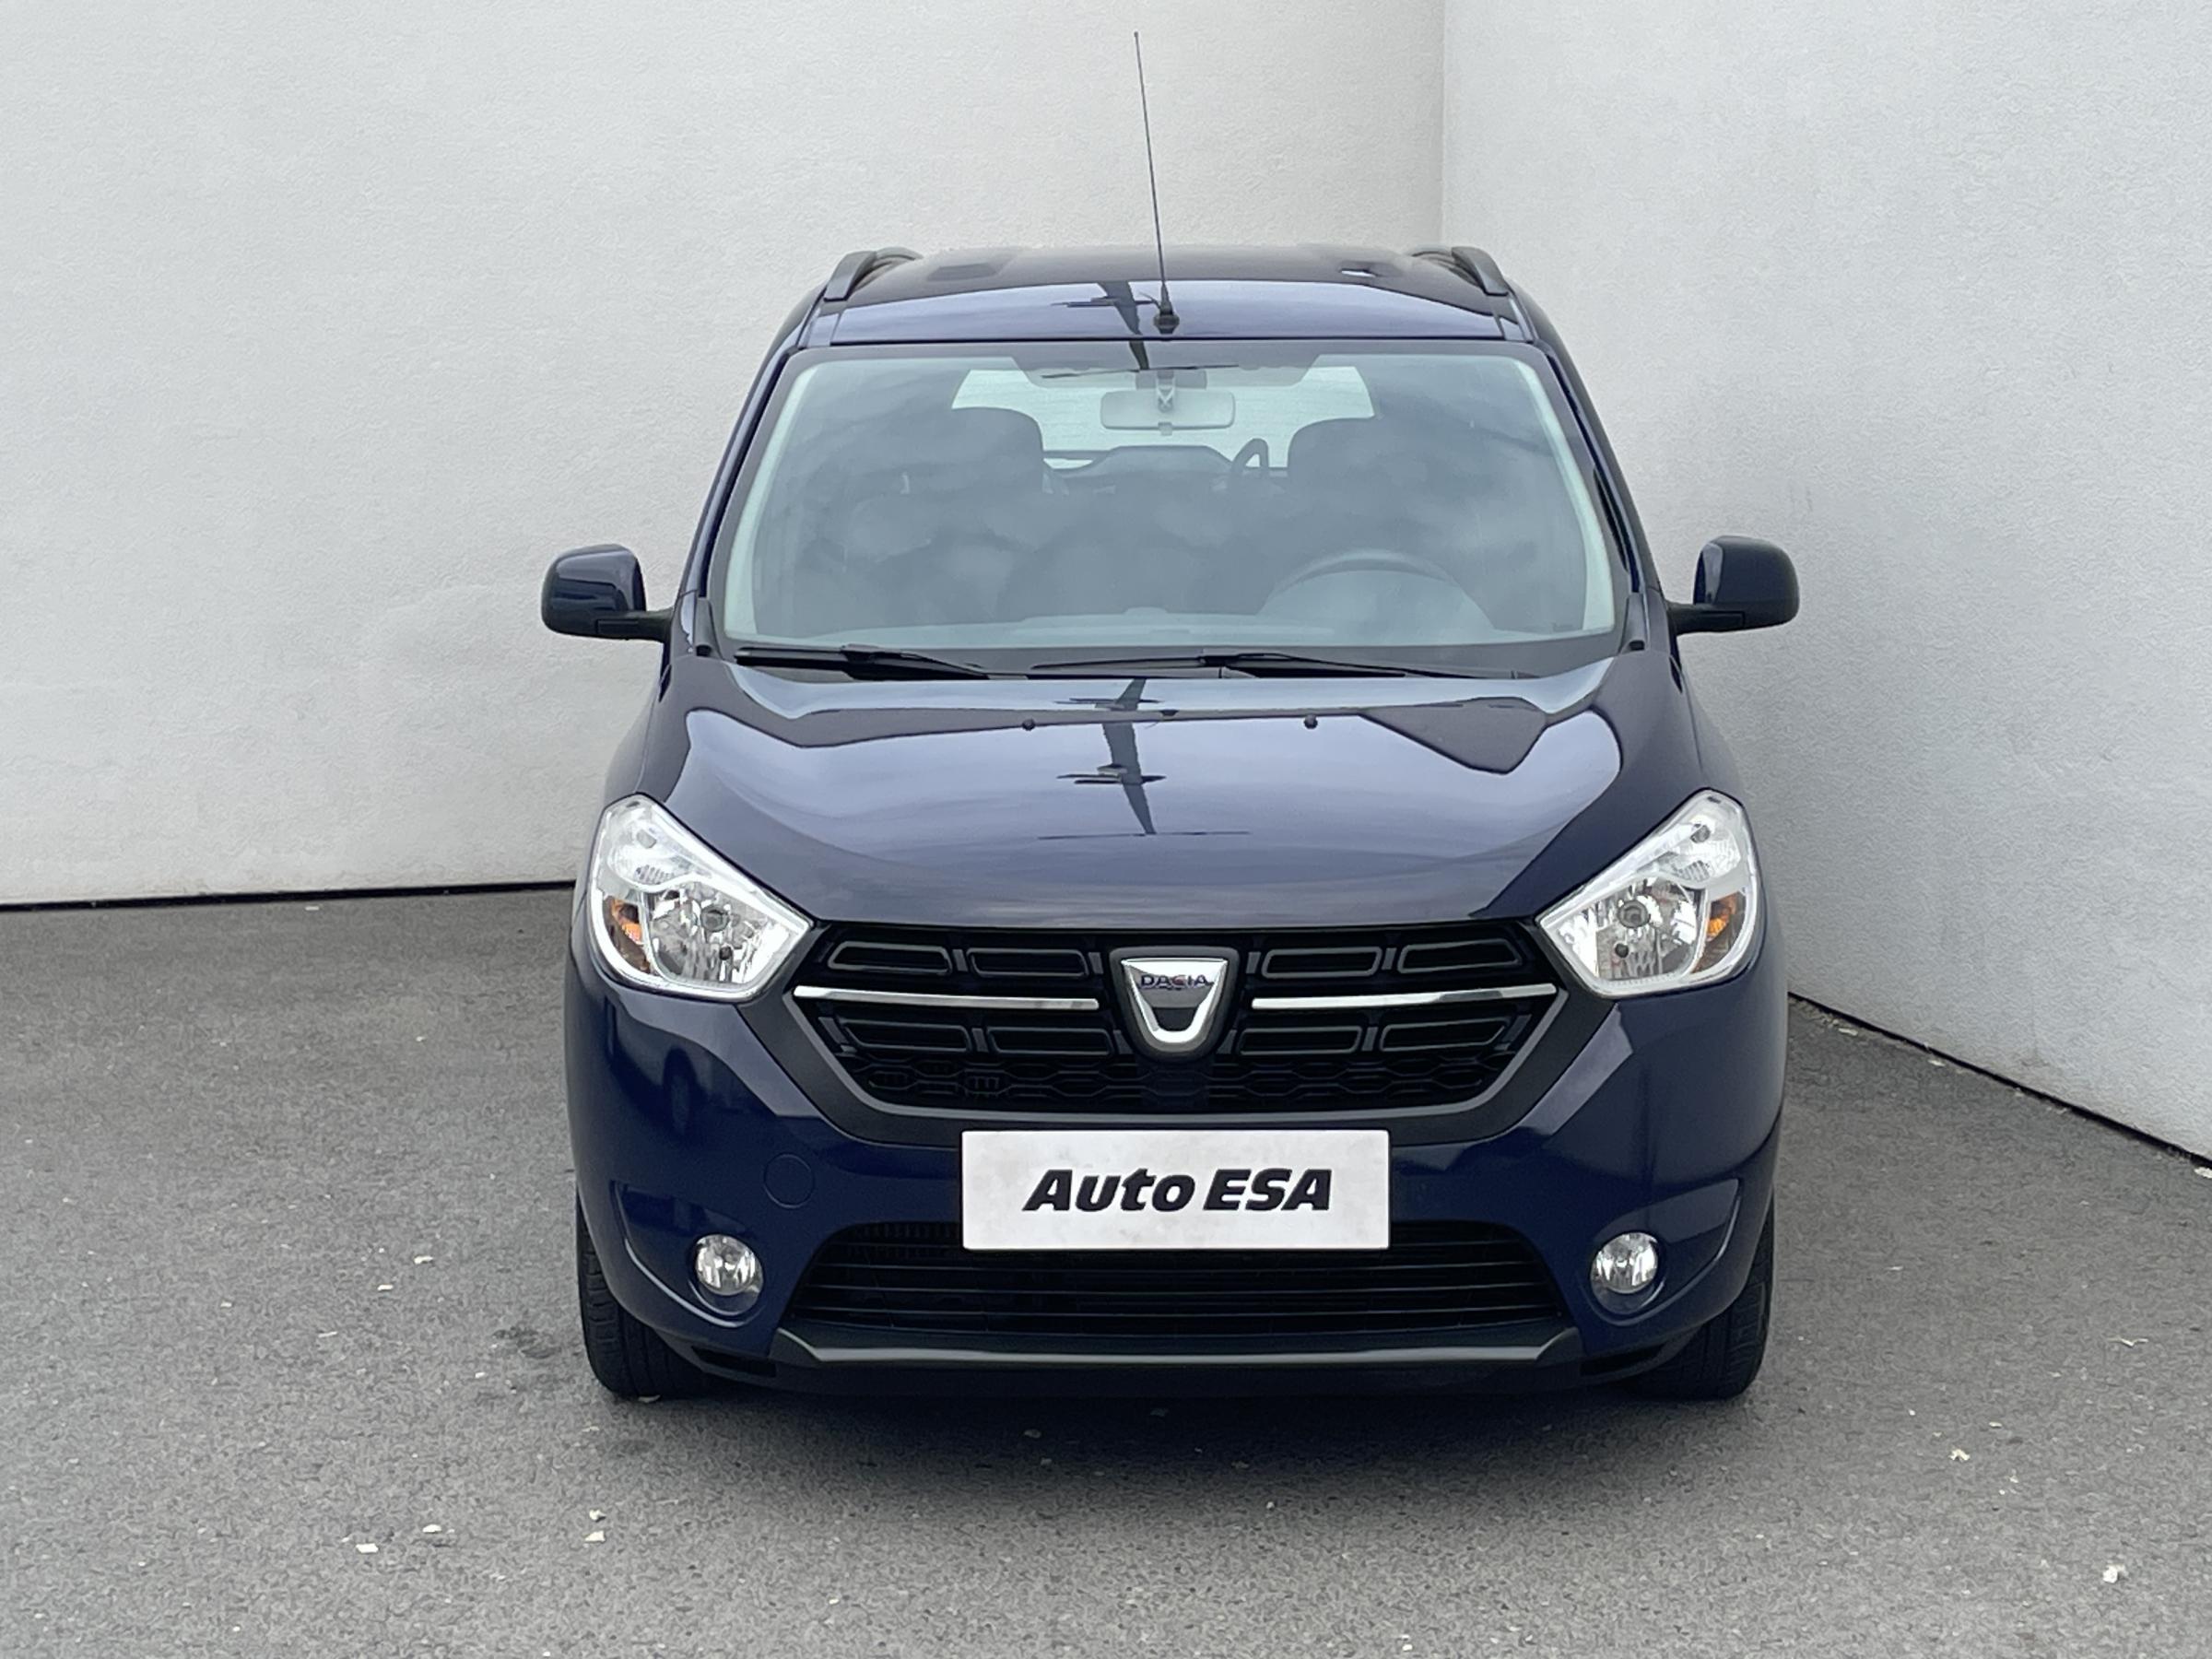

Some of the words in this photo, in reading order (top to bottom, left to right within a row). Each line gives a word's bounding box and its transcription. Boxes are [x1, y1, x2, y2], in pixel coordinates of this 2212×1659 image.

[1140, 973, 1210, 989] DACIA
[1022, 1168, 1196, 1213] Auto
[1202, 1168, 1333, 1212] ESA
